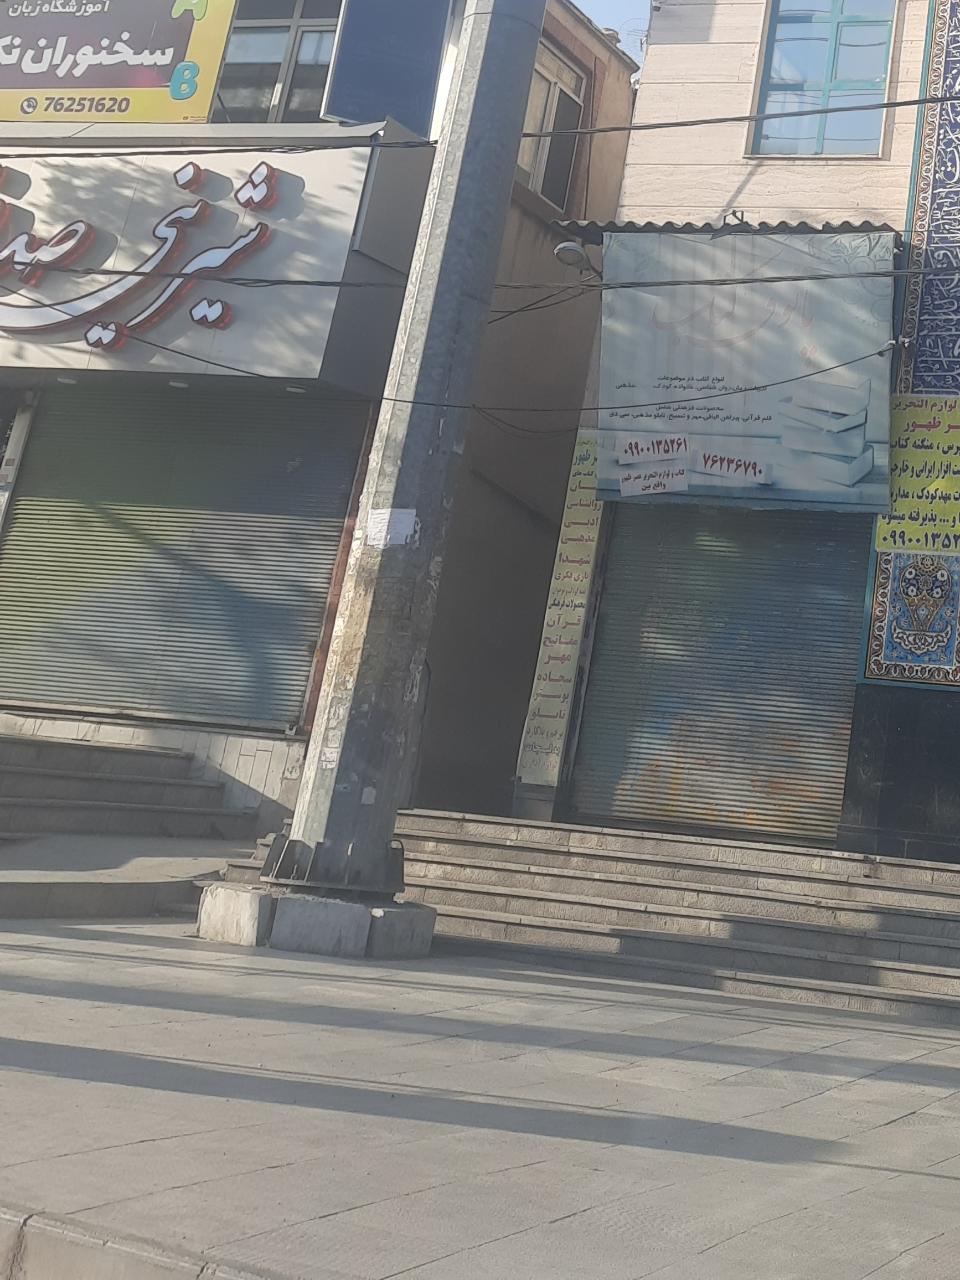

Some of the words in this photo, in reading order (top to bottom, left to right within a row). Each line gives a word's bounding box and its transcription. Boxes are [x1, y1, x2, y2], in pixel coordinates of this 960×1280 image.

[8, 0, 44, 18] زبان
[21, 31, 174, 79] سخنوران
[43, 96, 131, 114] 76251620
[930, 399, 958, 413] لوازم
[903, 416, 942, 433] ظهور
[623, 436, 689, 457] ۰۹۹۰۰۱۳۵۲۶۱
[702, 452, 763, 478] ۷۶۲۳۶۷۹۰
